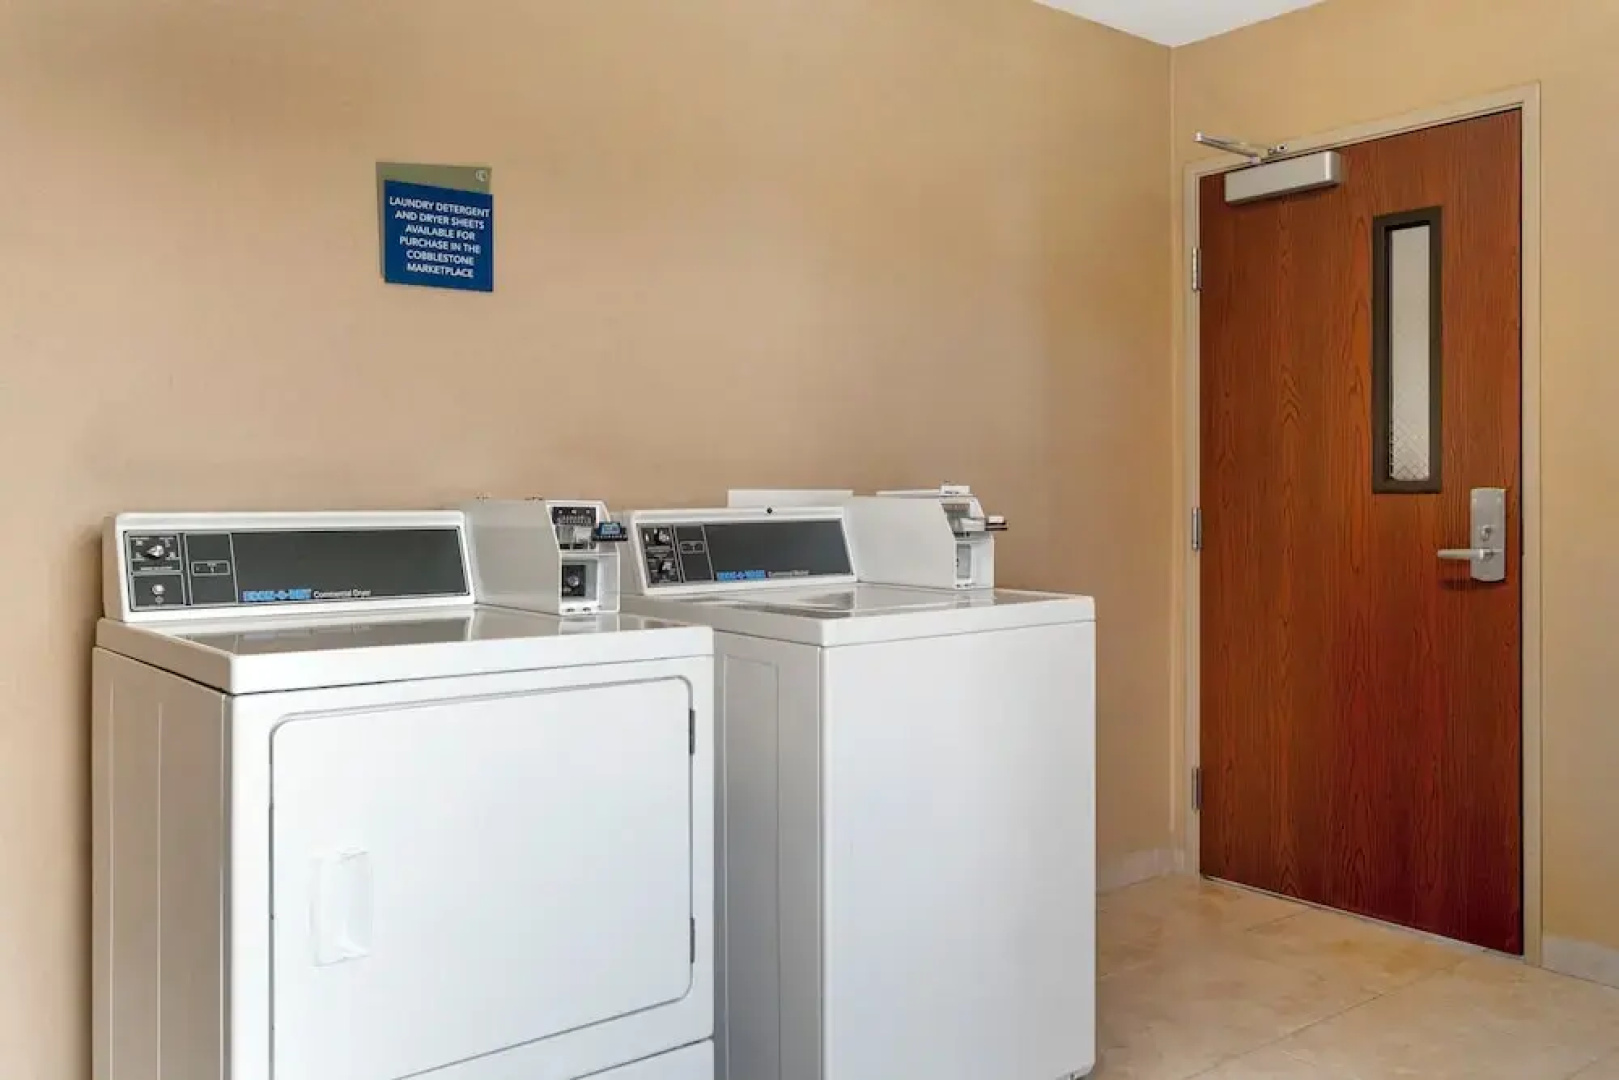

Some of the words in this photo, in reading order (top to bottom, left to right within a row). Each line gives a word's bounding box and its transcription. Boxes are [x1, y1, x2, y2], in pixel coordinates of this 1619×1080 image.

[389, 196, 434, 210] LAUNDRY
[436, 202, 490, 217] DETERGENT
[395, 210, 418, 220] AND
[419, 213, 449, 225] DRYER
[452, 217, 485, 230] SHEETS
[405, 225, 455, 238] AVAILABLE
[456, 230, 475, 241] FOR
[400, 236, 449, 250] PURCHASE
[450, 242, 461, 251] IN
[463, 243, 481, 254] THE
[406, 250, 474, 266] COBBLESTONE
[406, 263, 474, 278] MARKETPLACE
